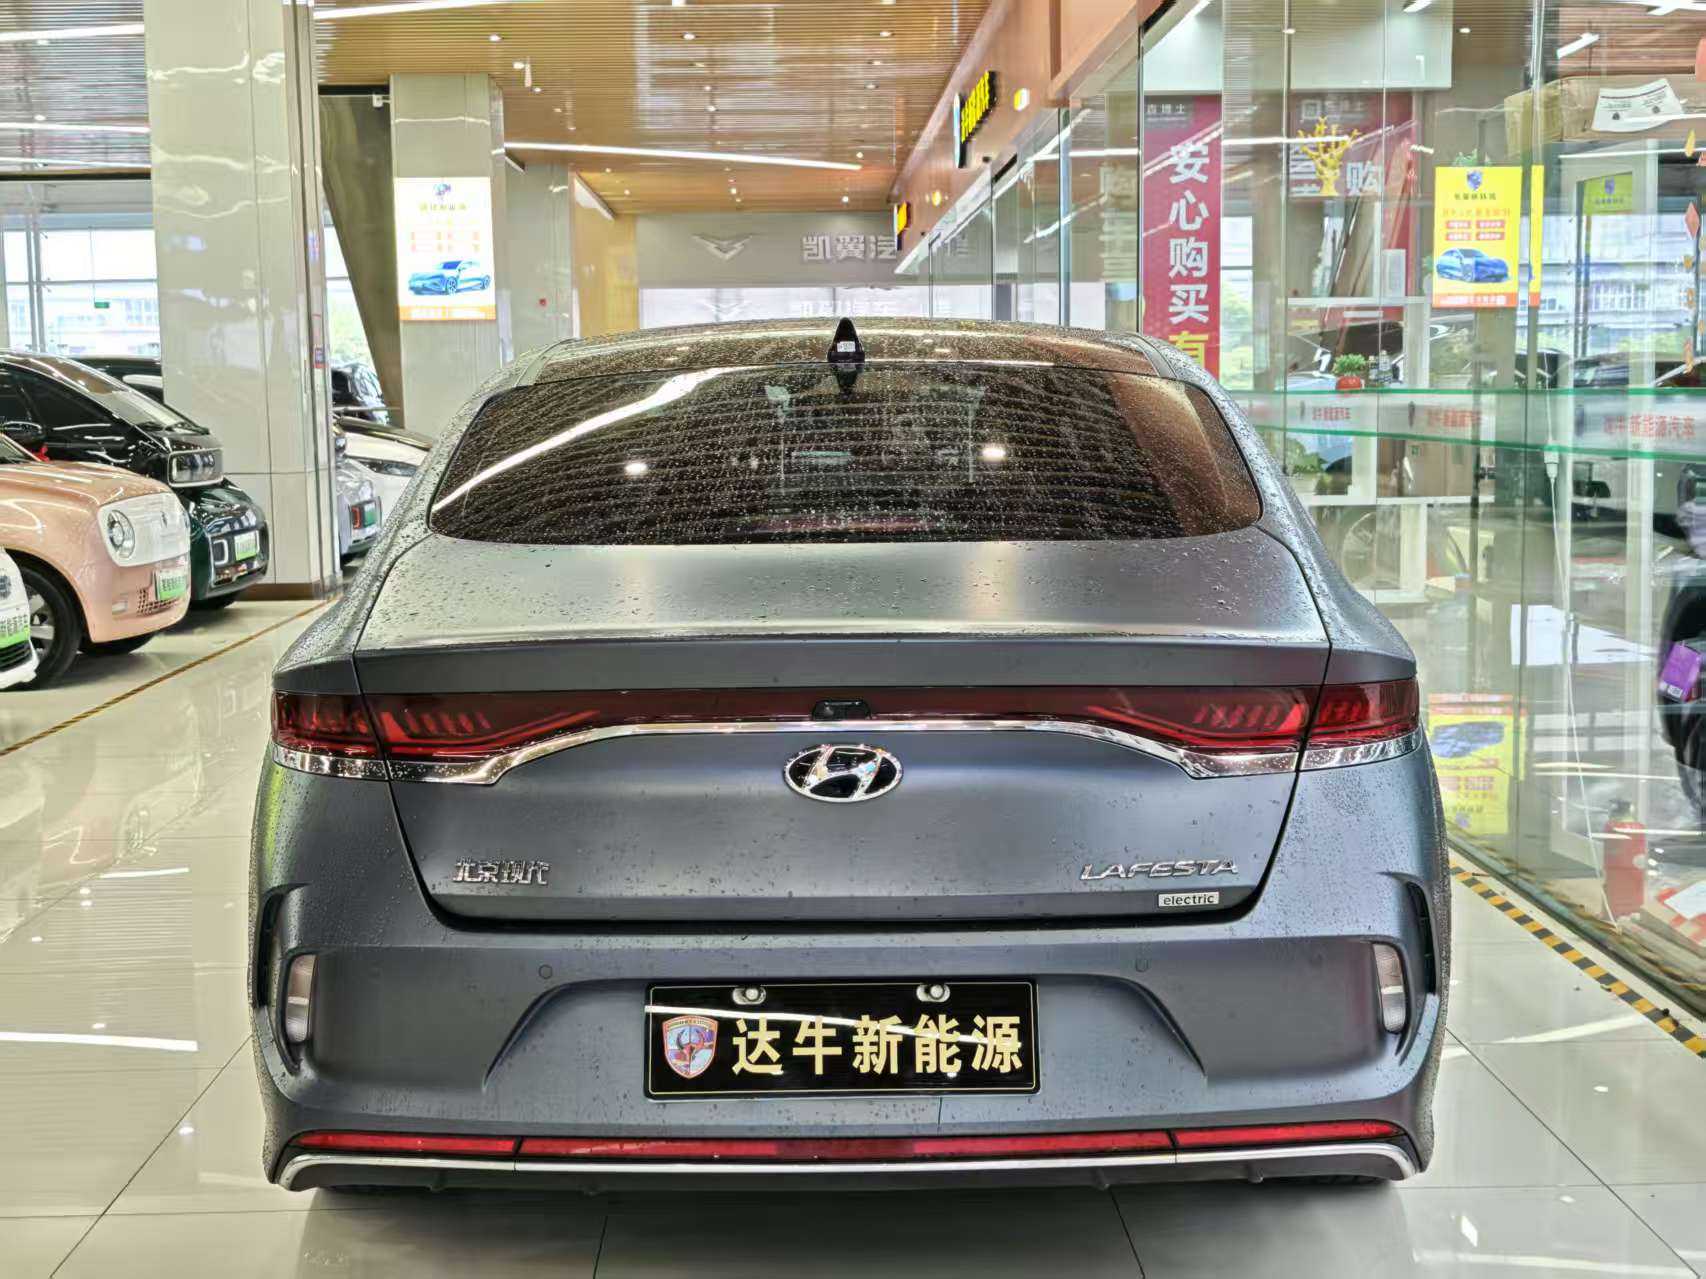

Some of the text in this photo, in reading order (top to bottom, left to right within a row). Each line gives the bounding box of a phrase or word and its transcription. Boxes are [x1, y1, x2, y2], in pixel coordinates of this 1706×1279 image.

[453, 859, 550, 885] 北京现代
[1080, 858, 1239, 881] LAFESTA
[1163, 893, 1215, 906] electric
[732, 1014, 1024, 1075] 达牛新能源
